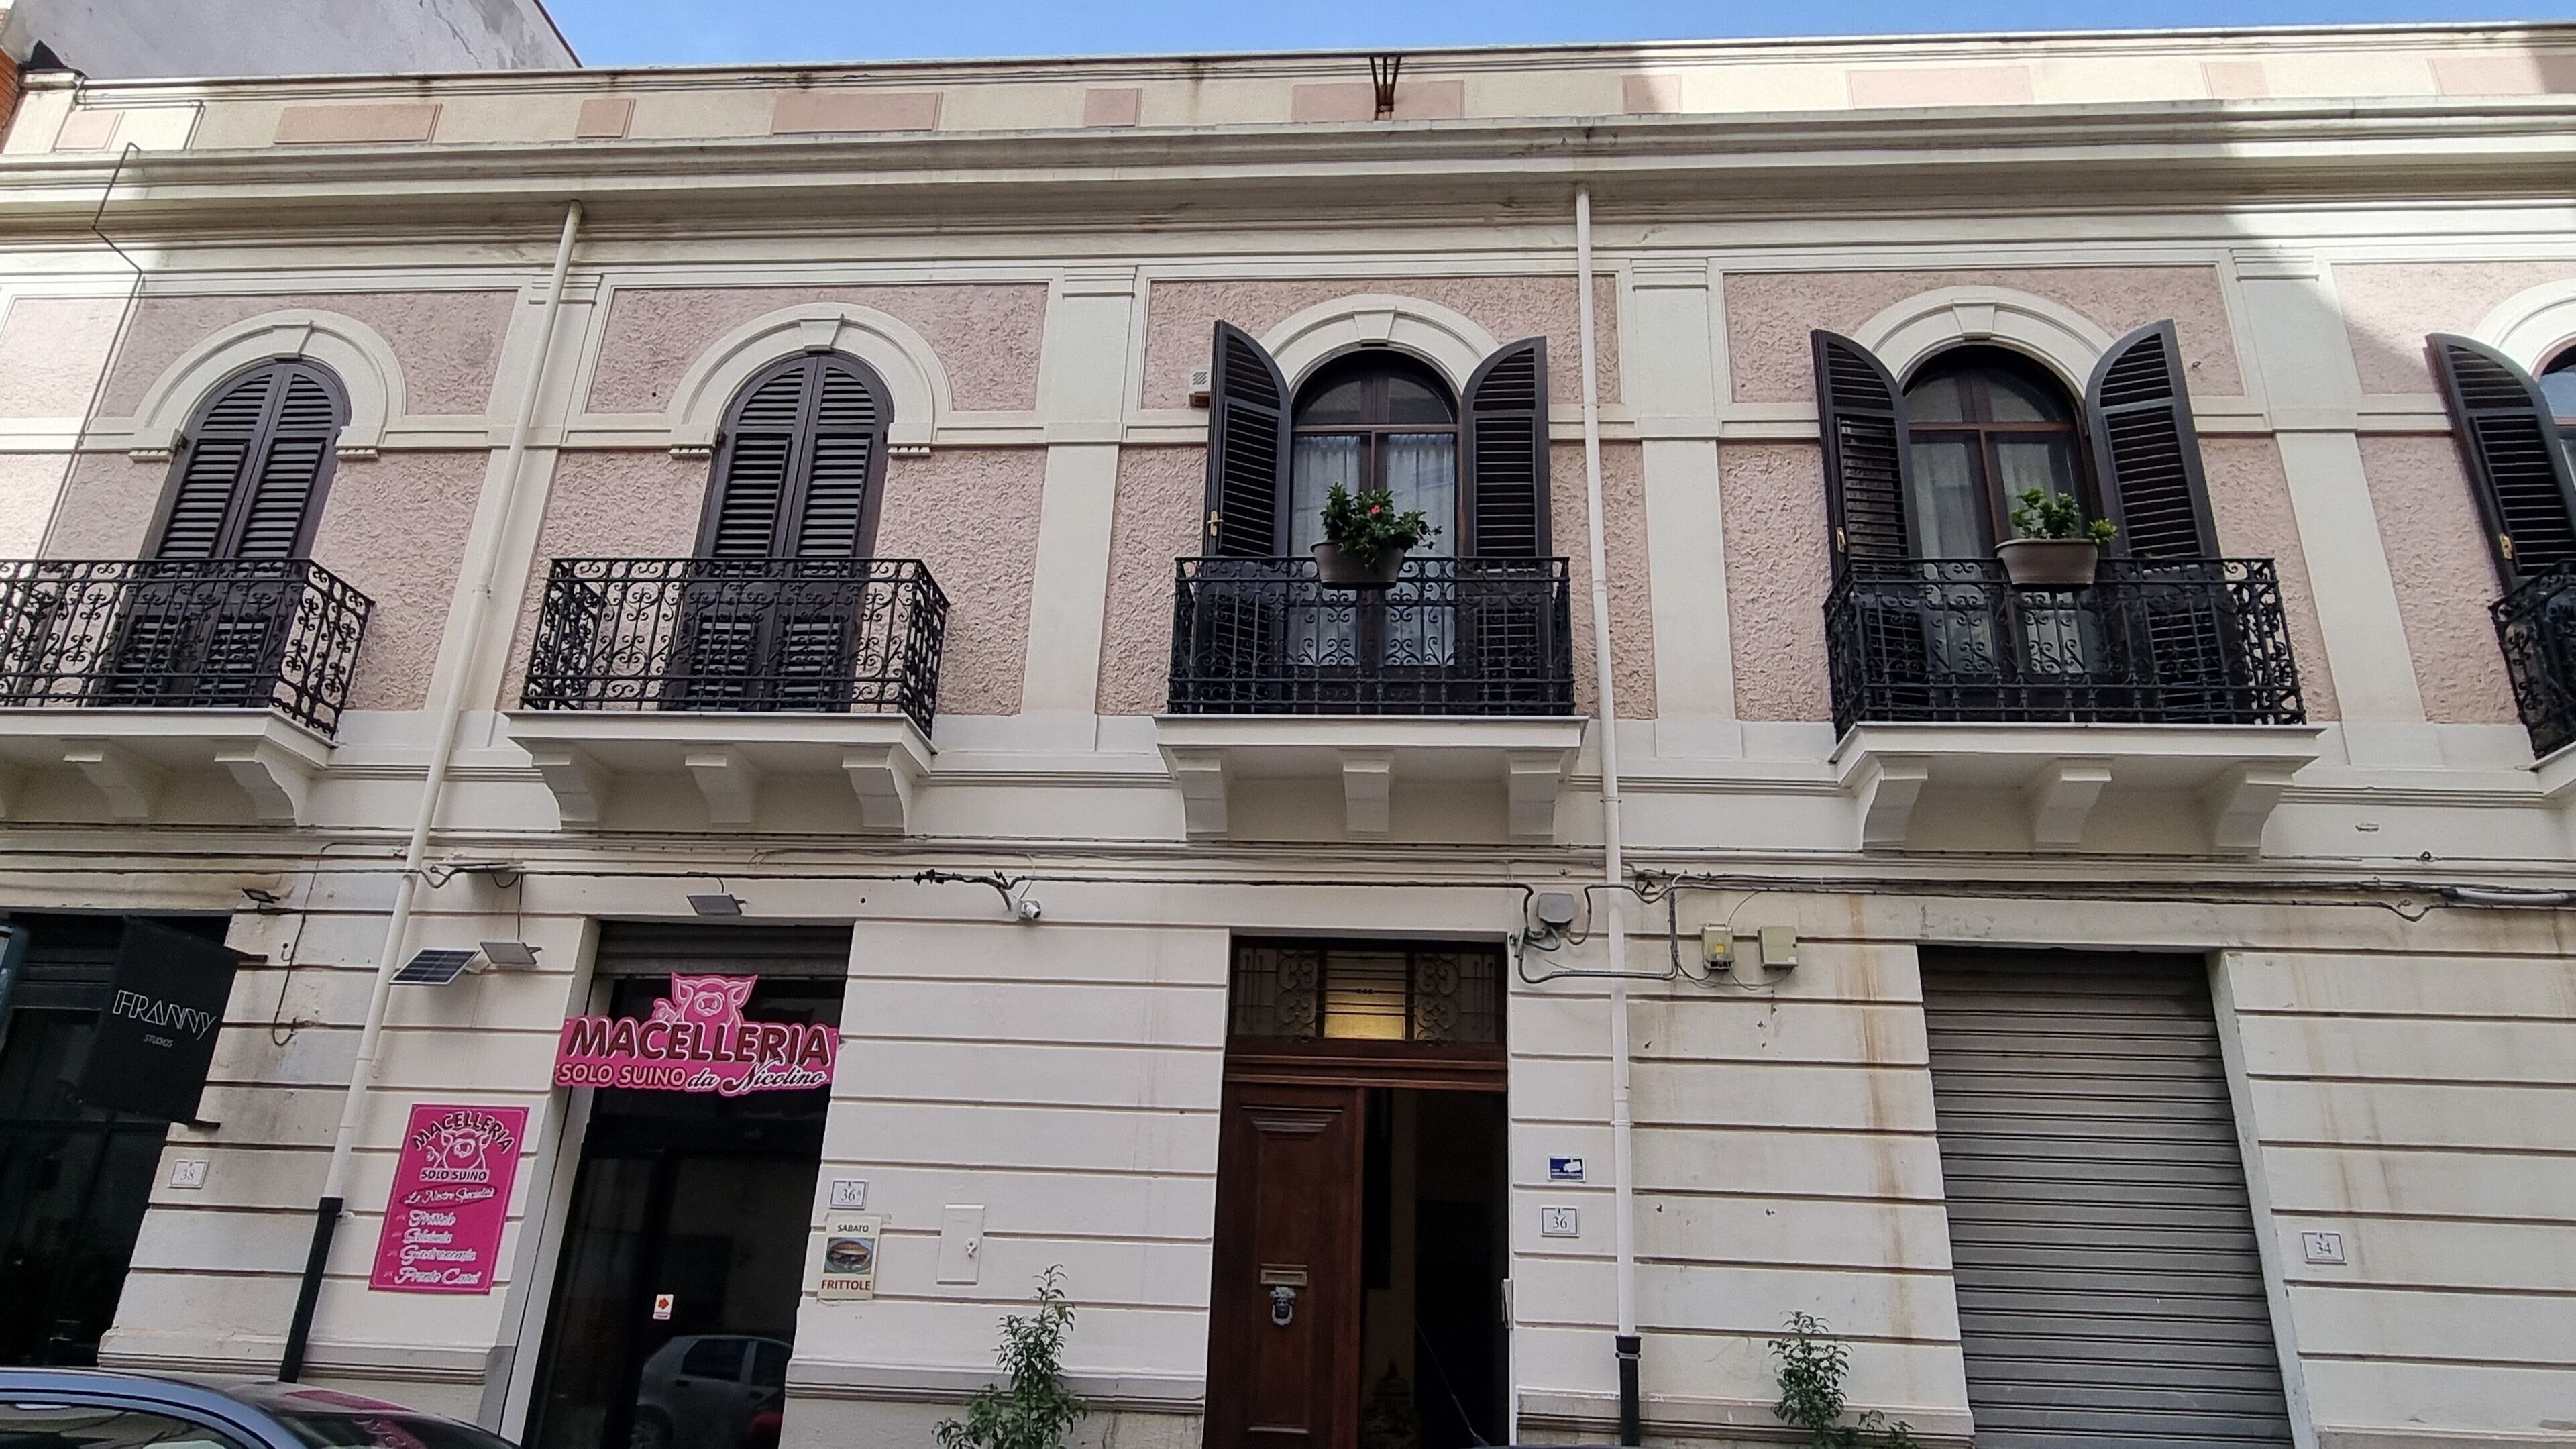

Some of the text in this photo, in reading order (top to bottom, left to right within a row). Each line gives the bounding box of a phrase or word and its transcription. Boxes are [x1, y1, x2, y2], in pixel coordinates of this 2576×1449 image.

[112, 989, 217, 1040] FRANNY
[143, 1034, 174, 1048] STUDIOS
[566, 1018, 832, 1066] MACELLERIA
[557, 1060, 827, 1095] SOLO SUINO da Nicolino
[412, 1111, 515, 1154] MACELLERIA
[180, 1169, 195, 1181] 38
[421, 1169, 488, 1181] SOLO SUINO
[837, 1224, 869, 1233] SABATO
[1552, 1216, 1568, 1229] 36
[2316, 1241, 2332, 1254] 34
[821, 1279, 871, 1291] FRITTOLE
